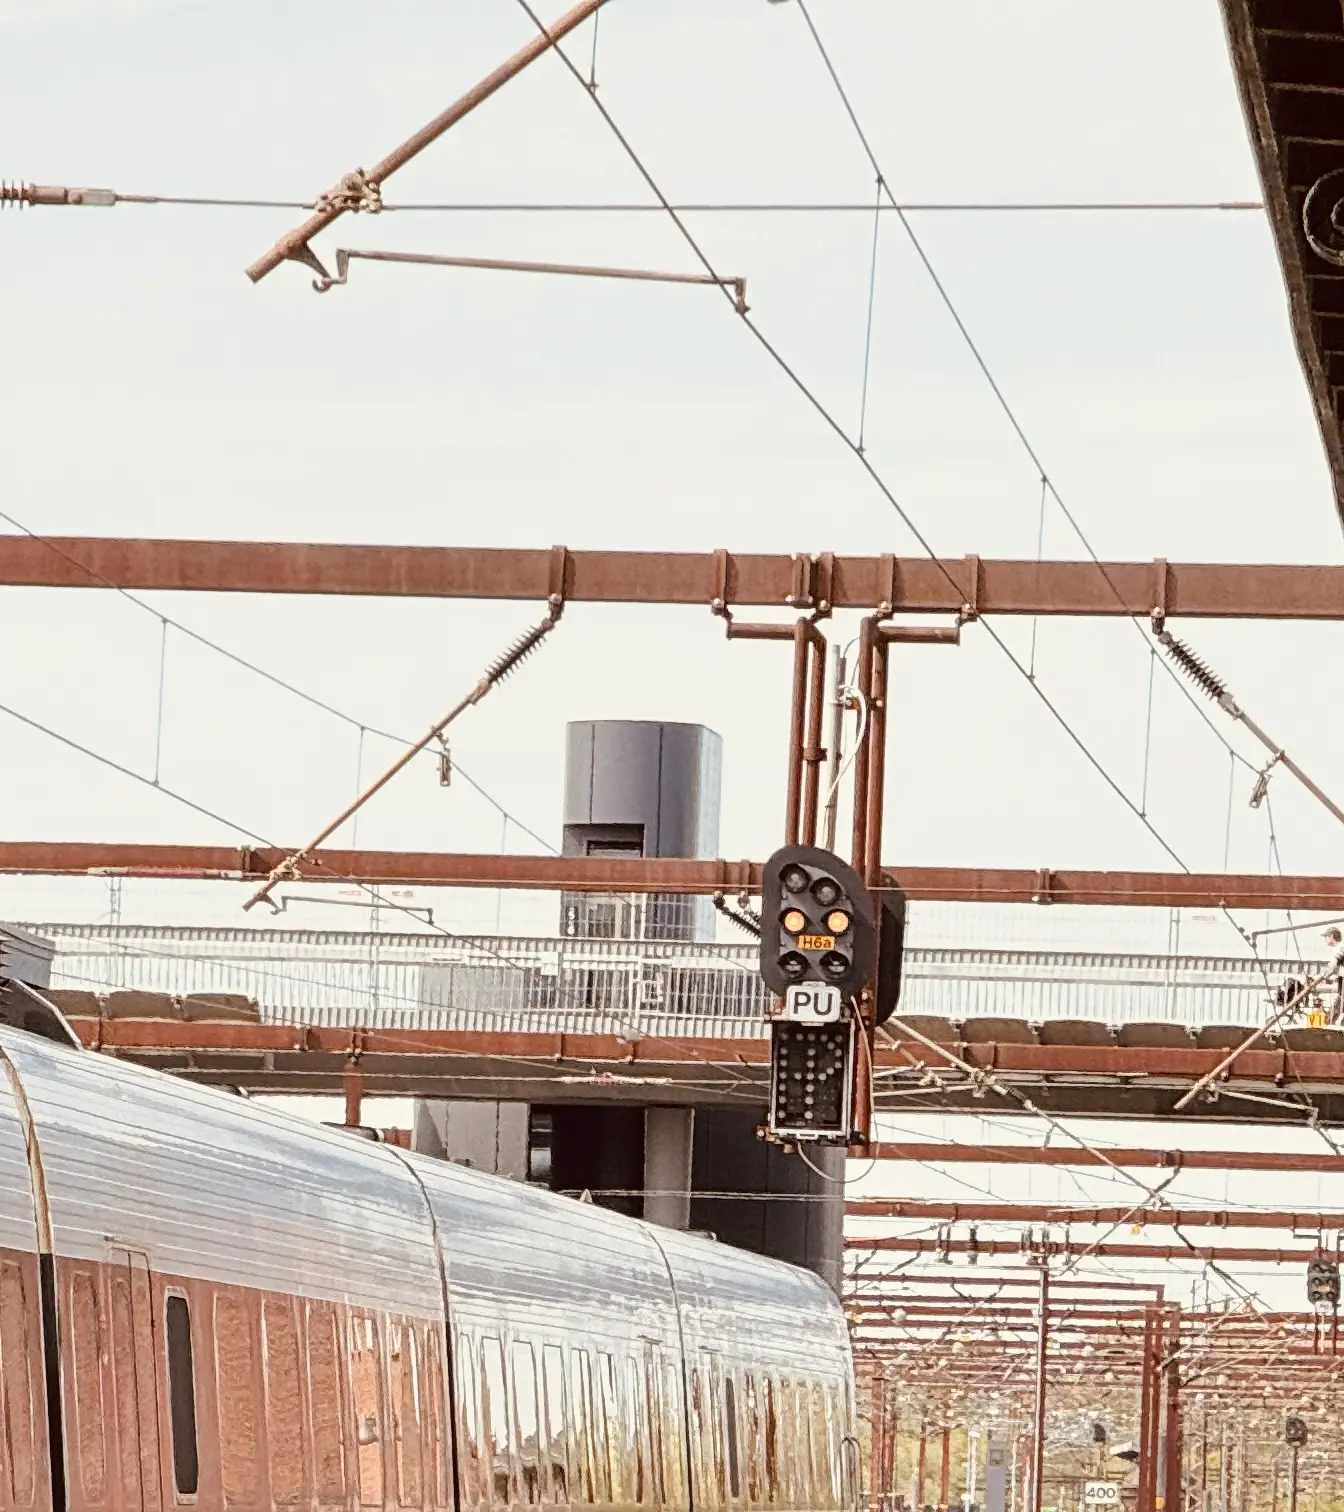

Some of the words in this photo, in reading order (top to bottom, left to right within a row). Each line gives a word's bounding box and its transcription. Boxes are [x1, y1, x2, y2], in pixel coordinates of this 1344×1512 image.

[802, 936, 832, 949] H6a
[793, 991, 833, 1016] PU
[1086, 1487, 1116, 1499] 400
